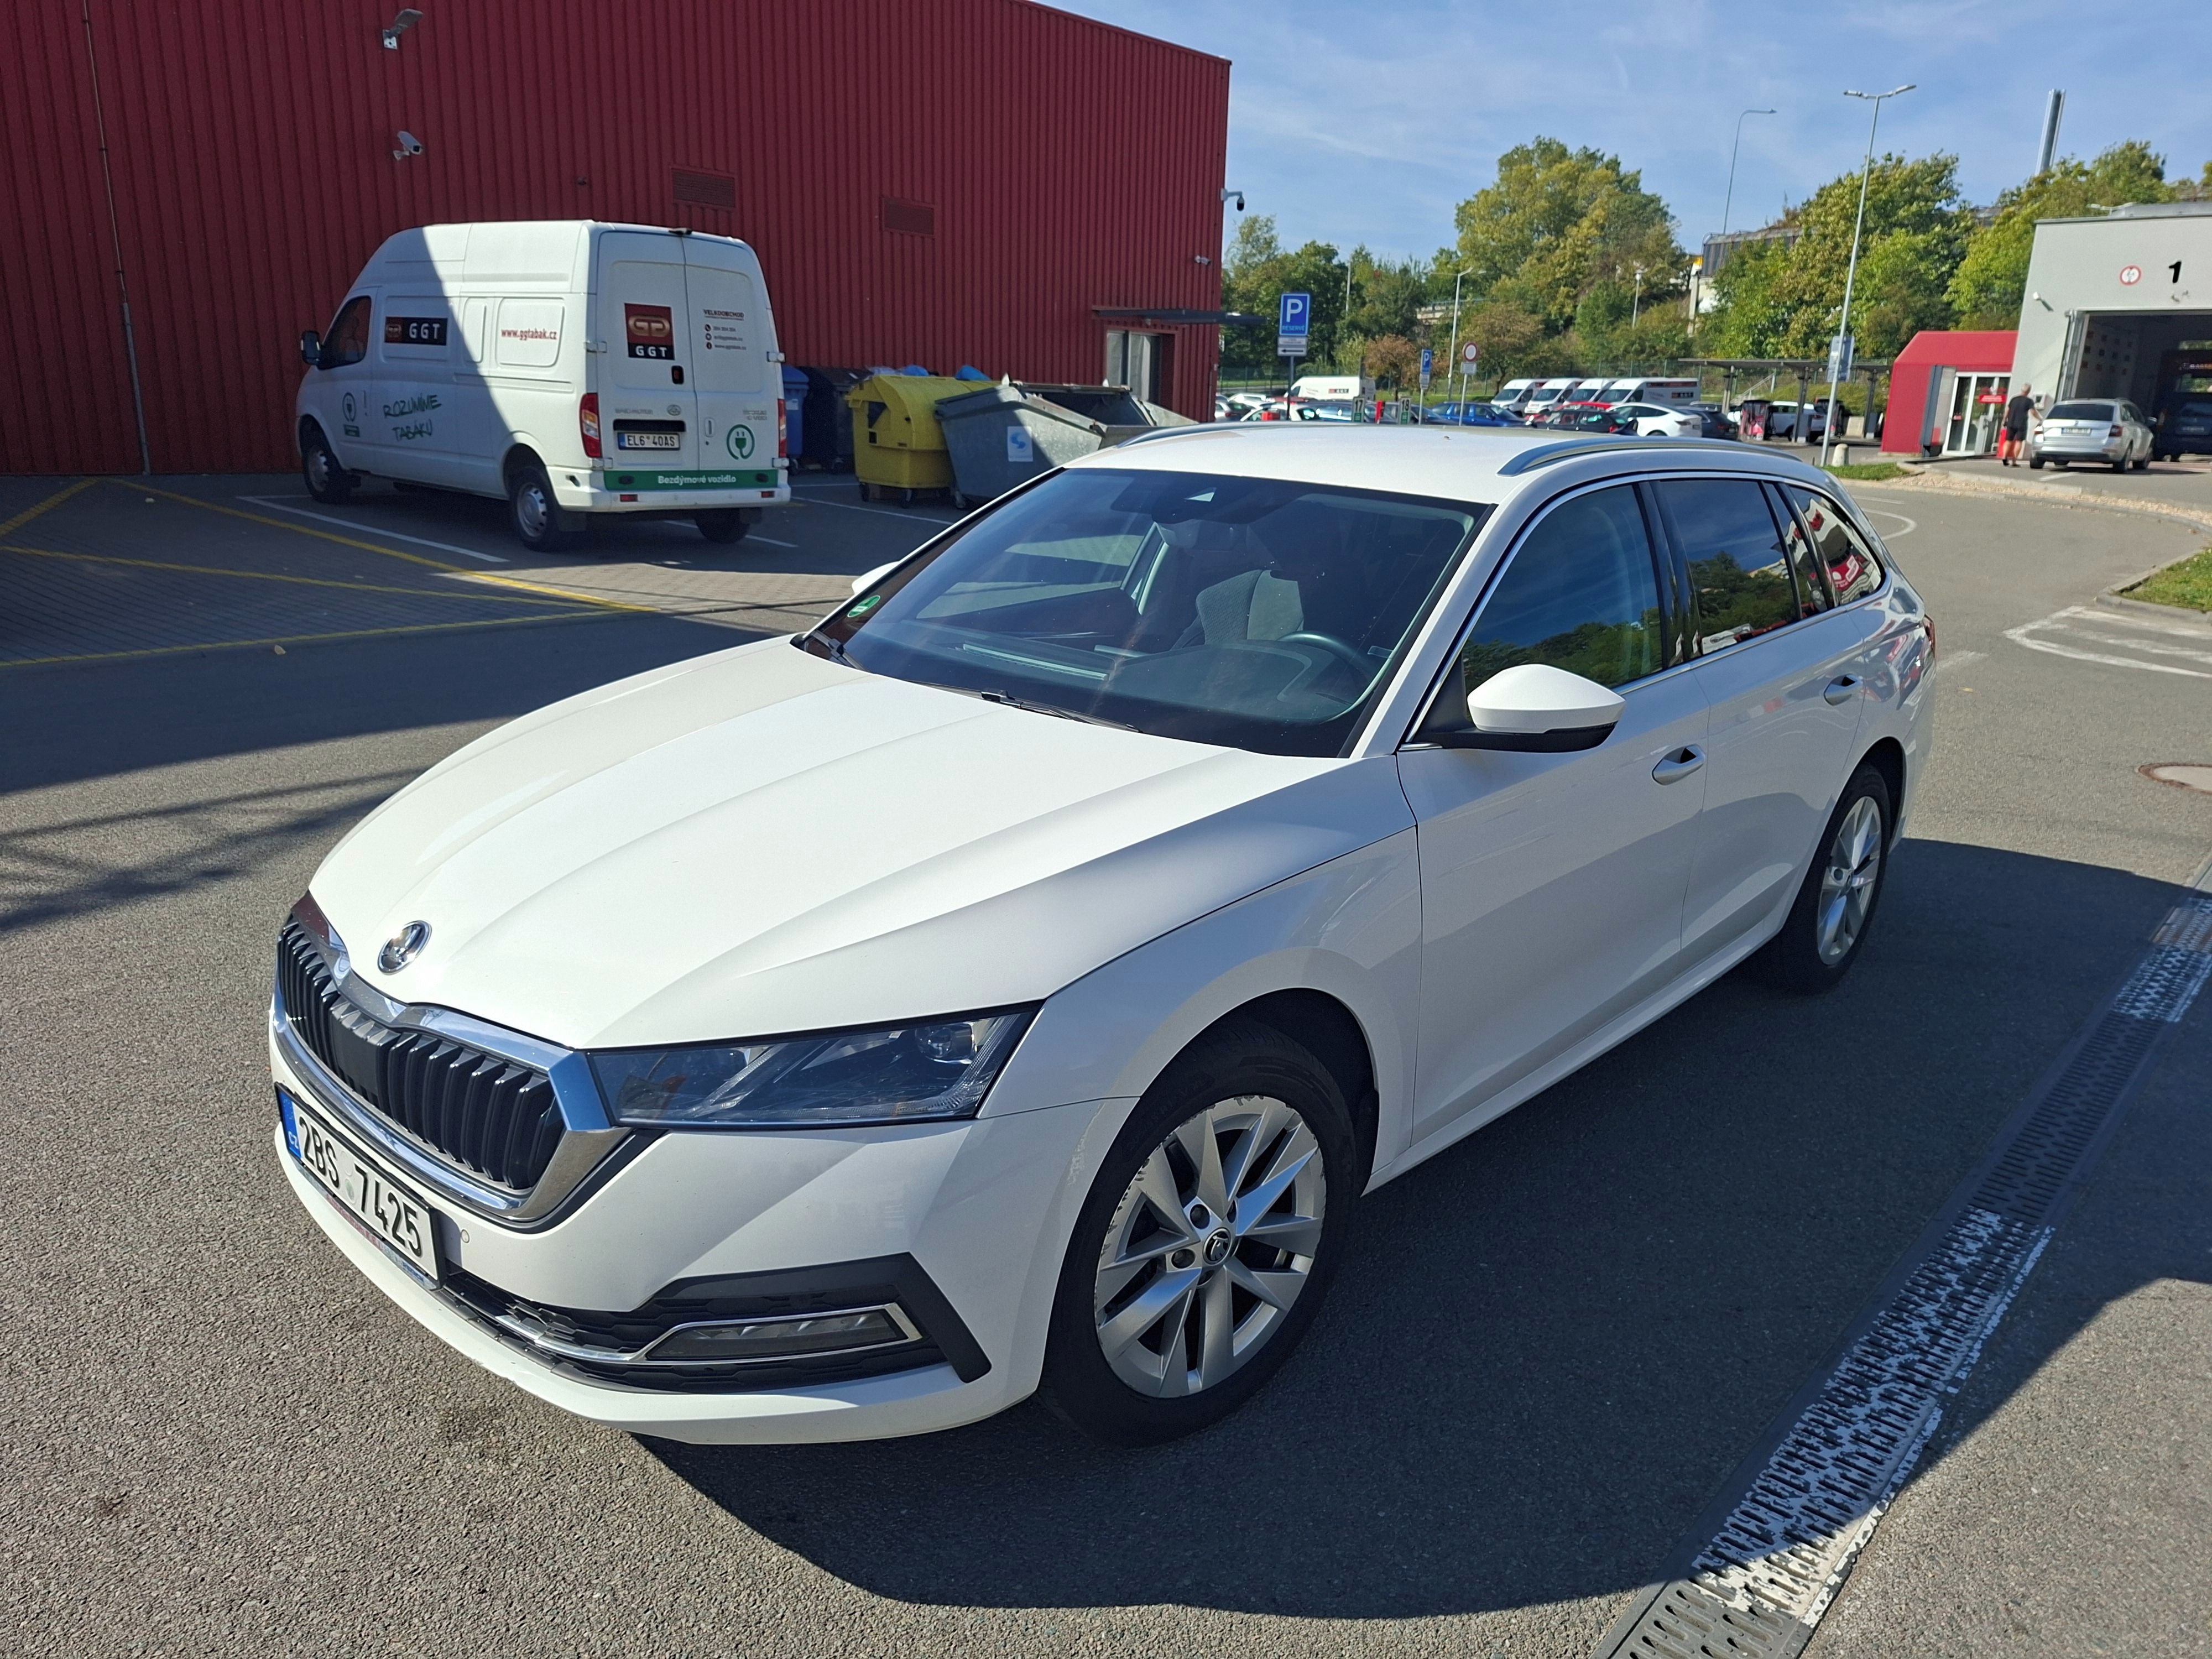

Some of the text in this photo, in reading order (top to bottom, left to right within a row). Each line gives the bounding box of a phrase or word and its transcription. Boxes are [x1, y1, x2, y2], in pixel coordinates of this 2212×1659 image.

[2169, 261, 2182, 283] 1
[1286, 299, 1303, 322] P
[409, 323, 440, 339] GGT
[501, 327, 557, 341] www.ggtabak.cz
[636, 345, 667, 357] GGT
[1423, 352, 1430, 366] P
[1355, 400, 1363, 412] 17
[1401, 399, 1410, 411] 18
[627, 434, 675, 447] EL6 40AS
[658, 475, 706, 486] Bezdýmové
[288, 1131, 299, 1150] CZ
[299, 1116, 340, 1188] 2BS
[354, 1163, 422, 1257] 7425
